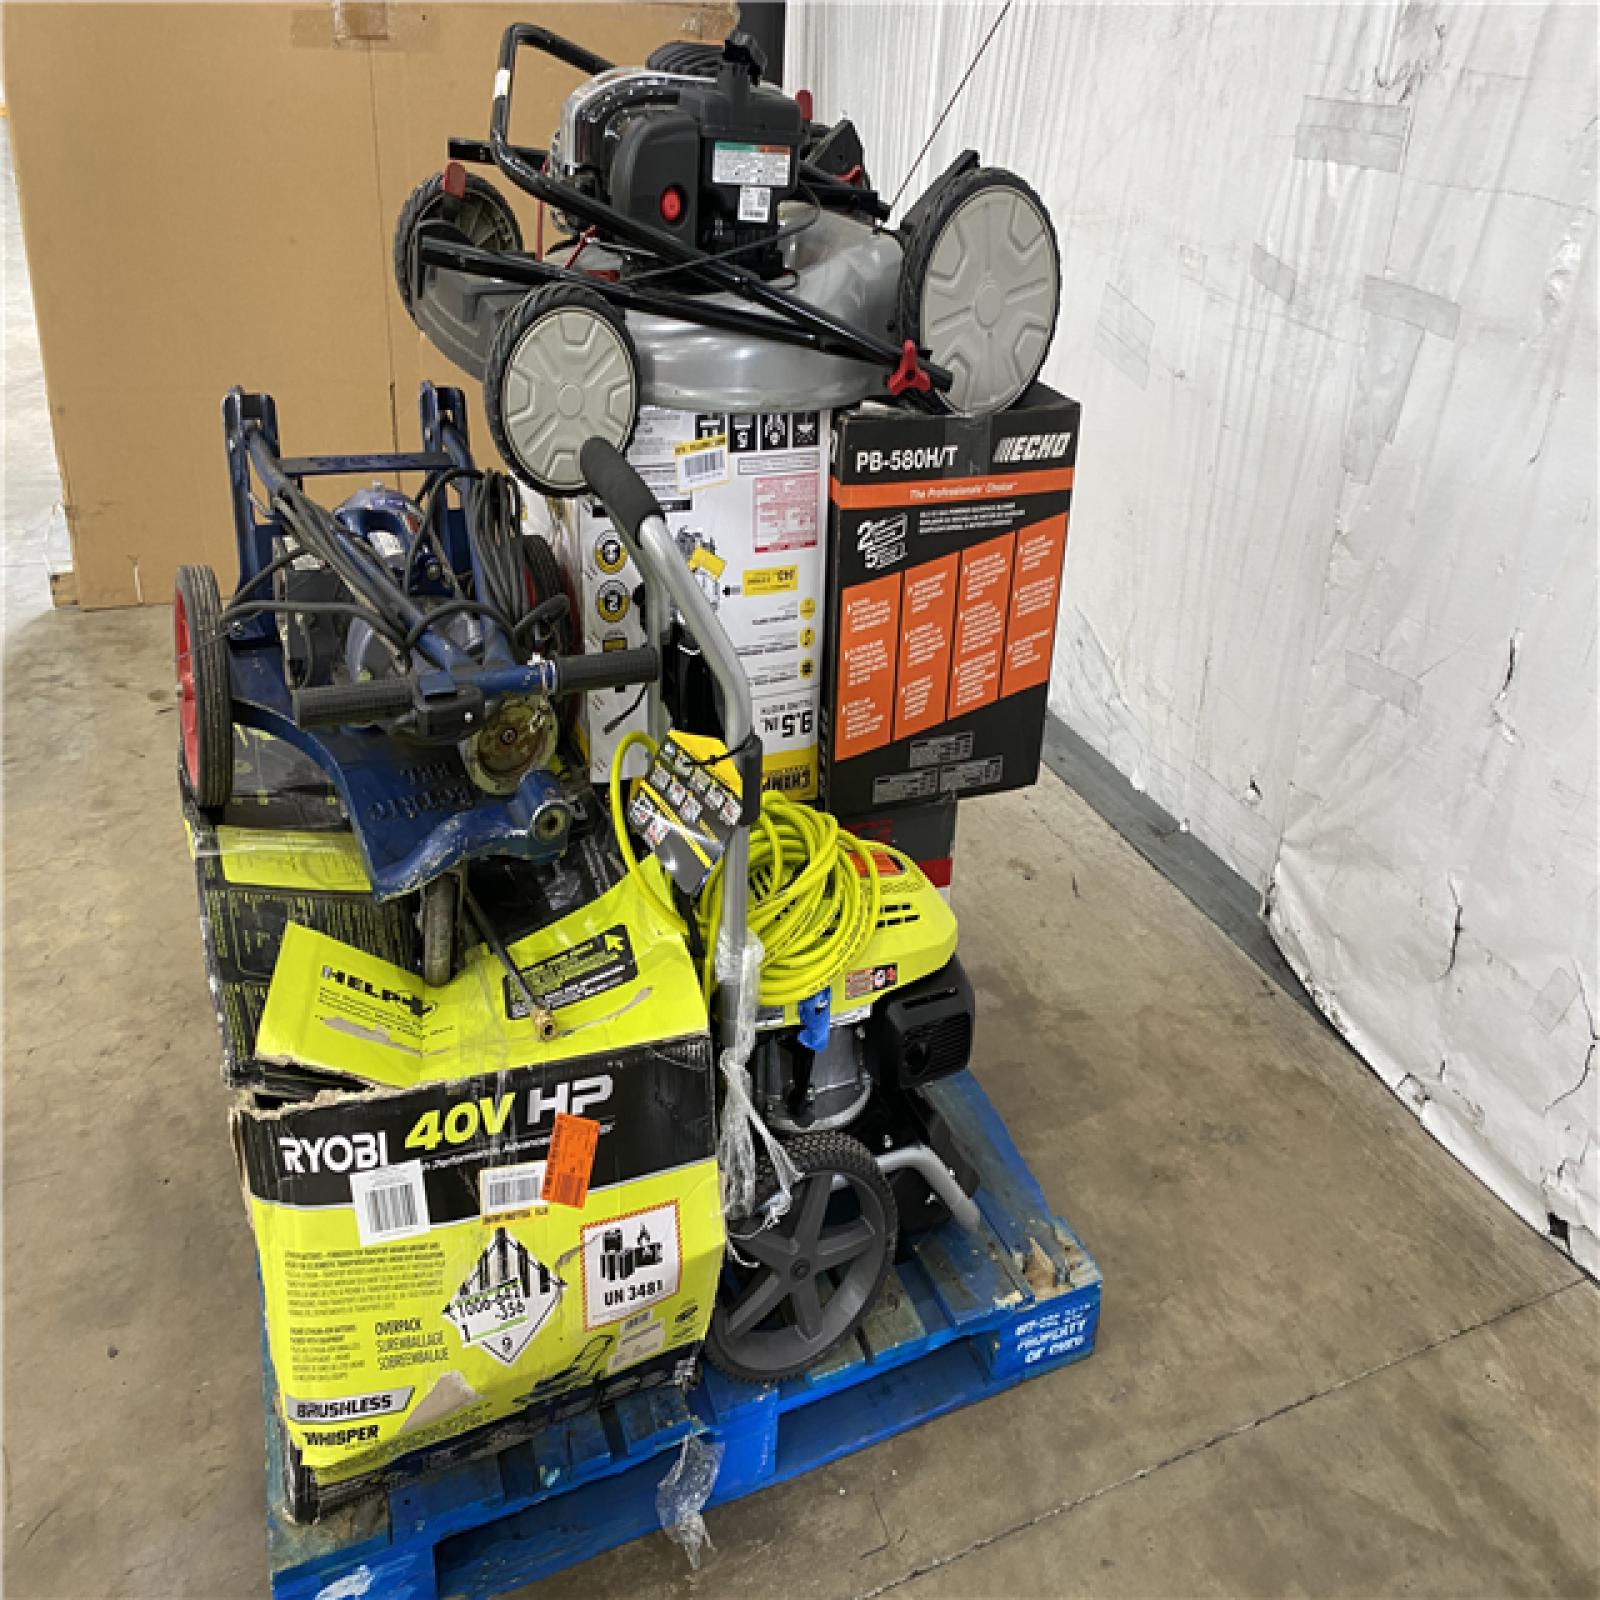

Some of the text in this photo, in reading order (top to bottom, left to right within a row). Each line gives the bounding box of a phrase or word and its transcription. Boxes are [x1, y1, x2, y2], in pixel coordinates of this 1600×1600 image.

[855, 445, 959, 474] PB-580H/T
[1011, 432, 1071, 461] ECHO
[526, 1075, 614, 1126] HP
[404, 1093, 516, 1150] 40V
[279, 1130, 389, 1174] RYOBI
[604, 1287, 624, 1306] UN
[627, 1278, 664, 1301] 3481
[296, 1394, 393, 1418] BRUSHLESS
[302, 1424, 379, 1446] WHISPER
